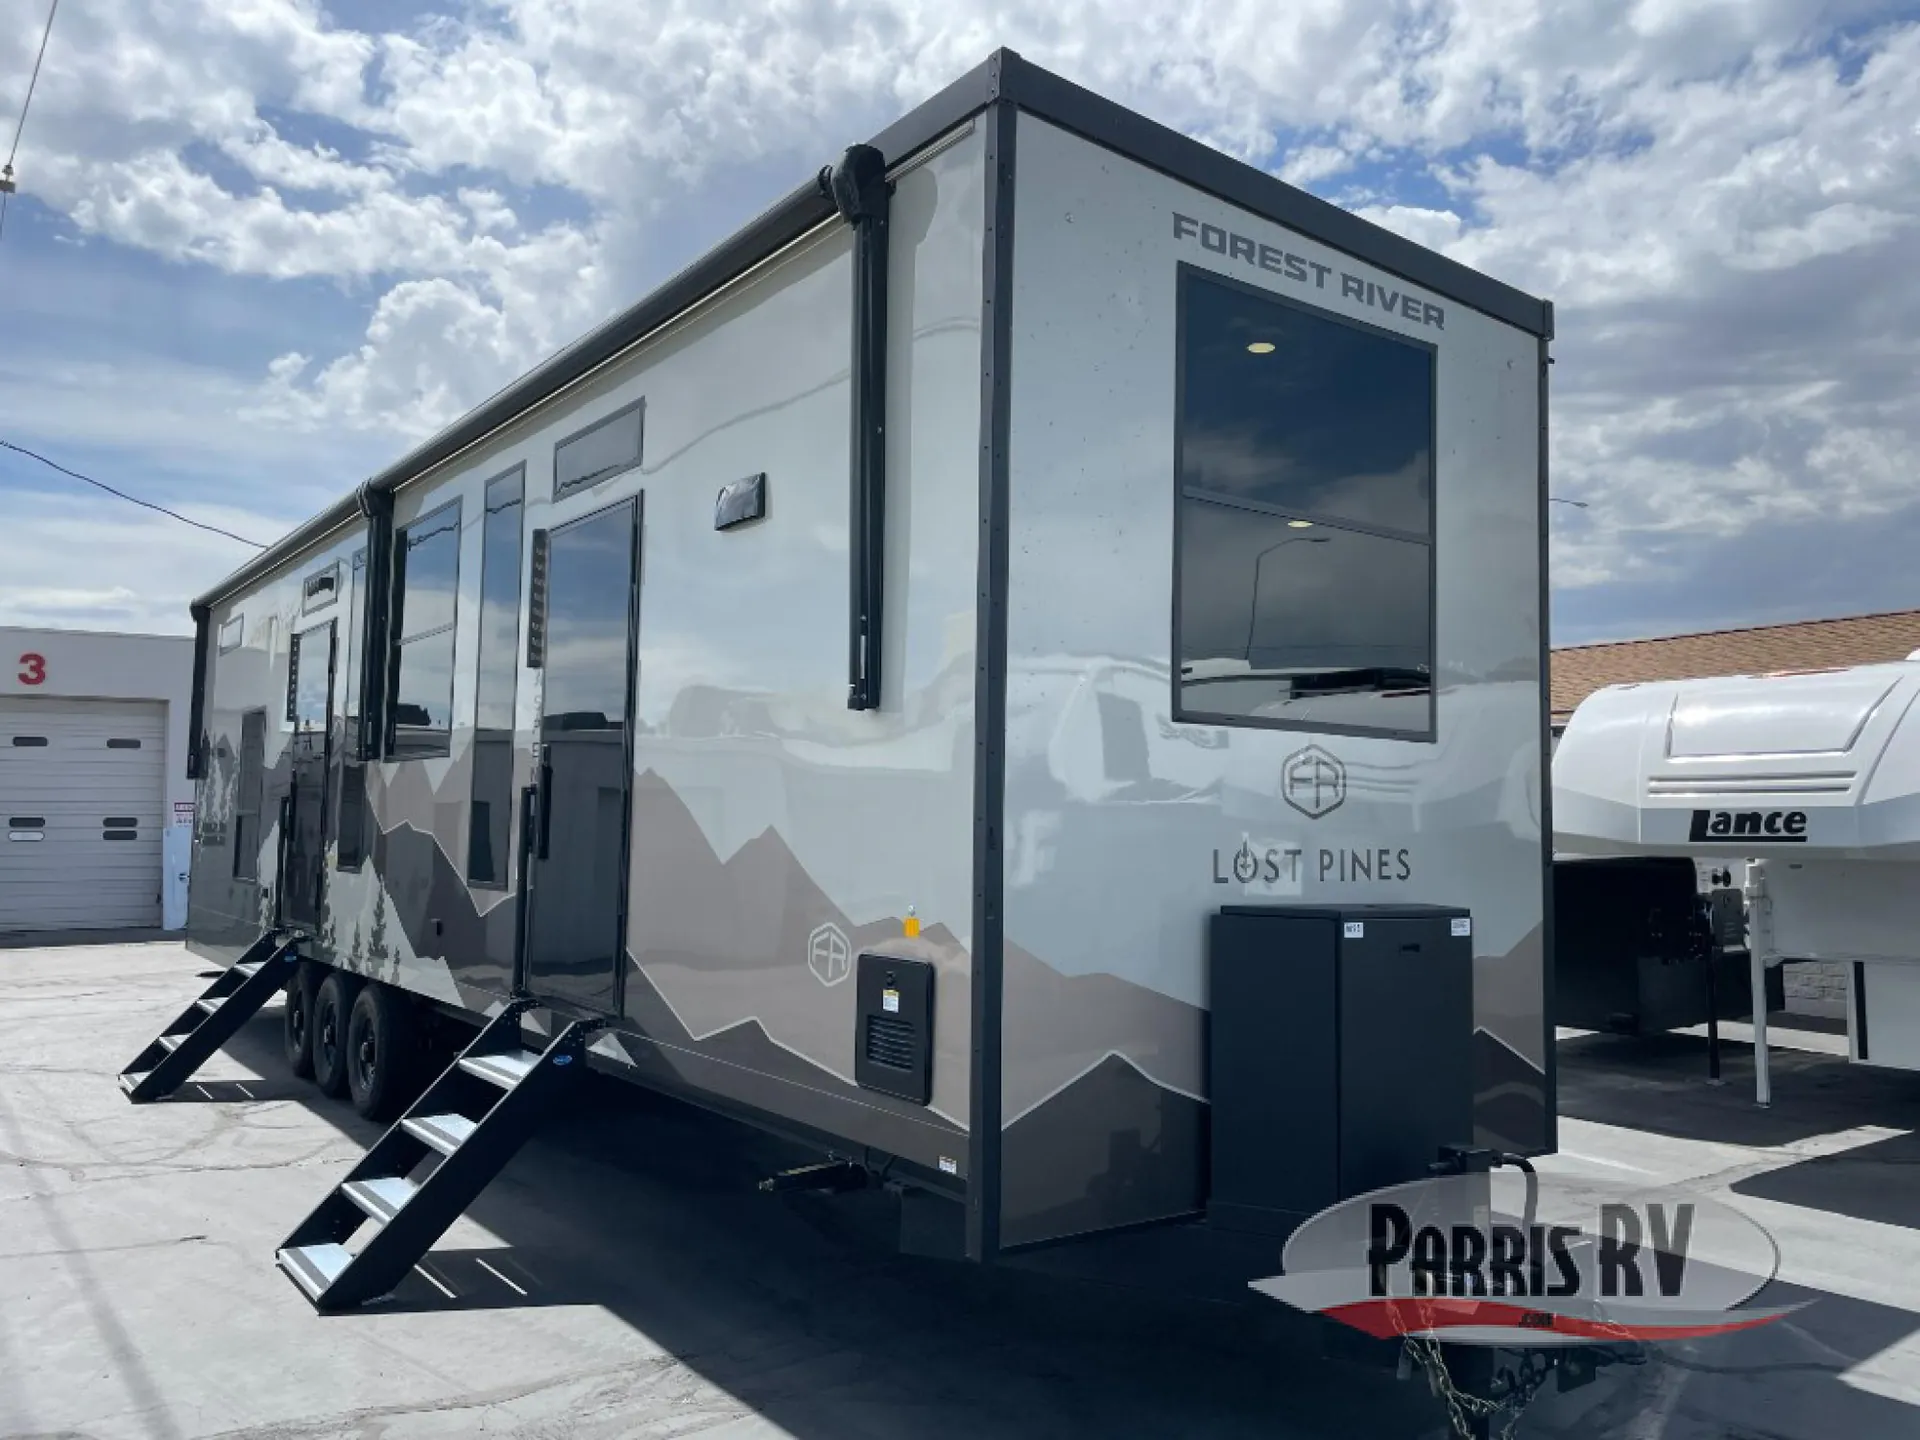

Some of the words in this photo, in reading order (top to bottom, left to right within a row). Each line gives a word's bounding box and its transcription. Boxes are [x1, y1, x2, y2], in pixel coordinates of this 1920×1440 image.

[1171, 211, 1333, 290] FOREST
[1339, 271, 1446, 331] RIVER
[17, 652, 47, 686] 3
[1688, 809, 1809, 843] Lance
[1212, 846, 1303, 884] LOST
[1319, 848, 1412, 883] PINES
